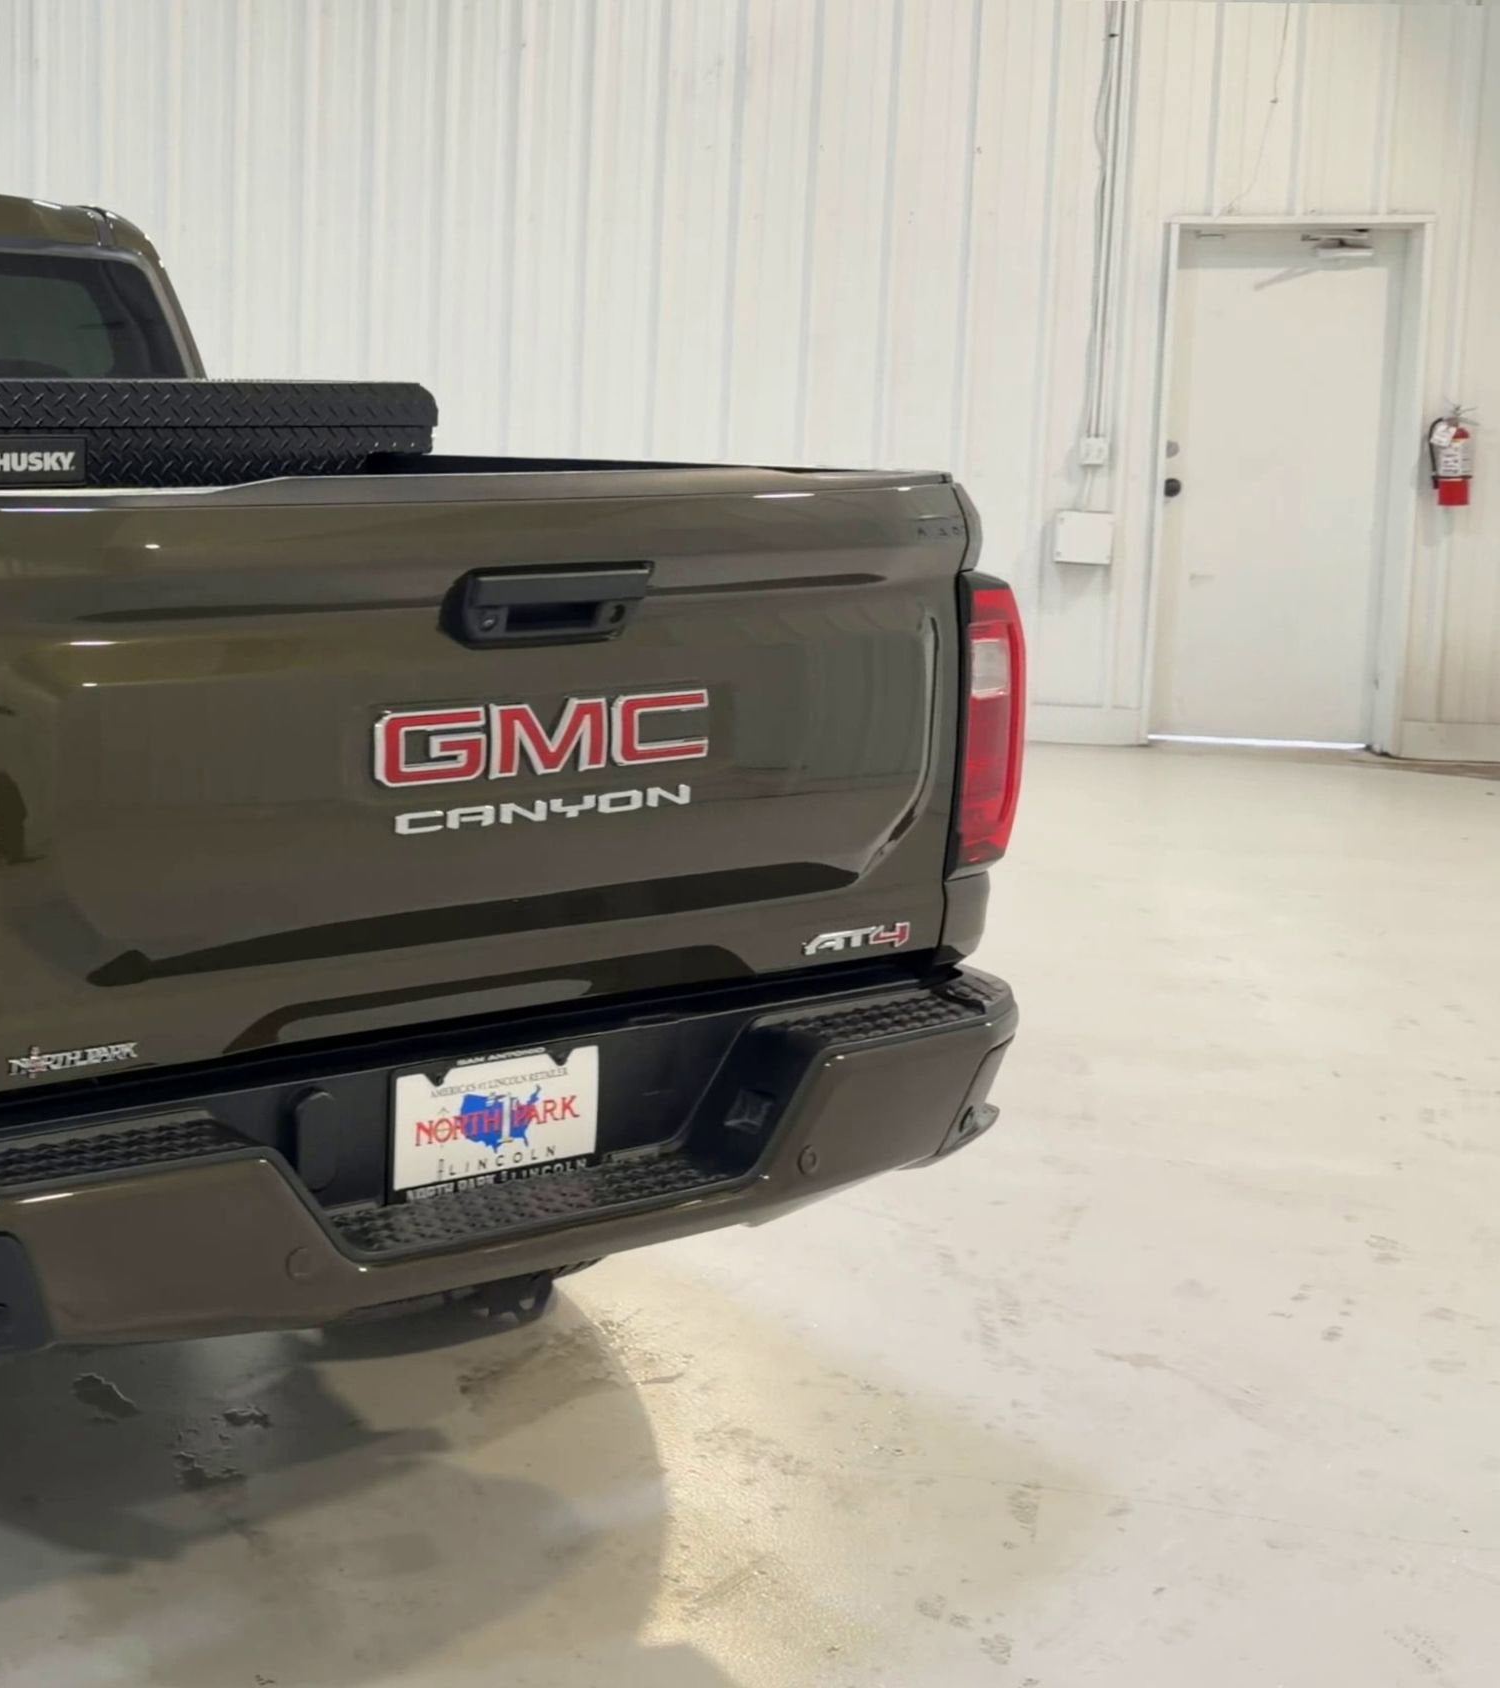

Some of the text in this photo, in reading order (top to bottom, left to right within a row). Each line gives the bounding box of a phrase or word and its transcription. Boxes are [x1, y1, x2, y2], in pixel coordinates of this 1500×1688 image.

[374, 688, 709, 788] GMC
[394, 784, 691, 835] CANYON
[802, 921, 910, 955] AT4
[456, 1047, 547, 1067] SAN ANTONIO
[415, 1096, 580, 1147] NORTH PARK
[449, 1146, 556, 1176] LINCOLN
